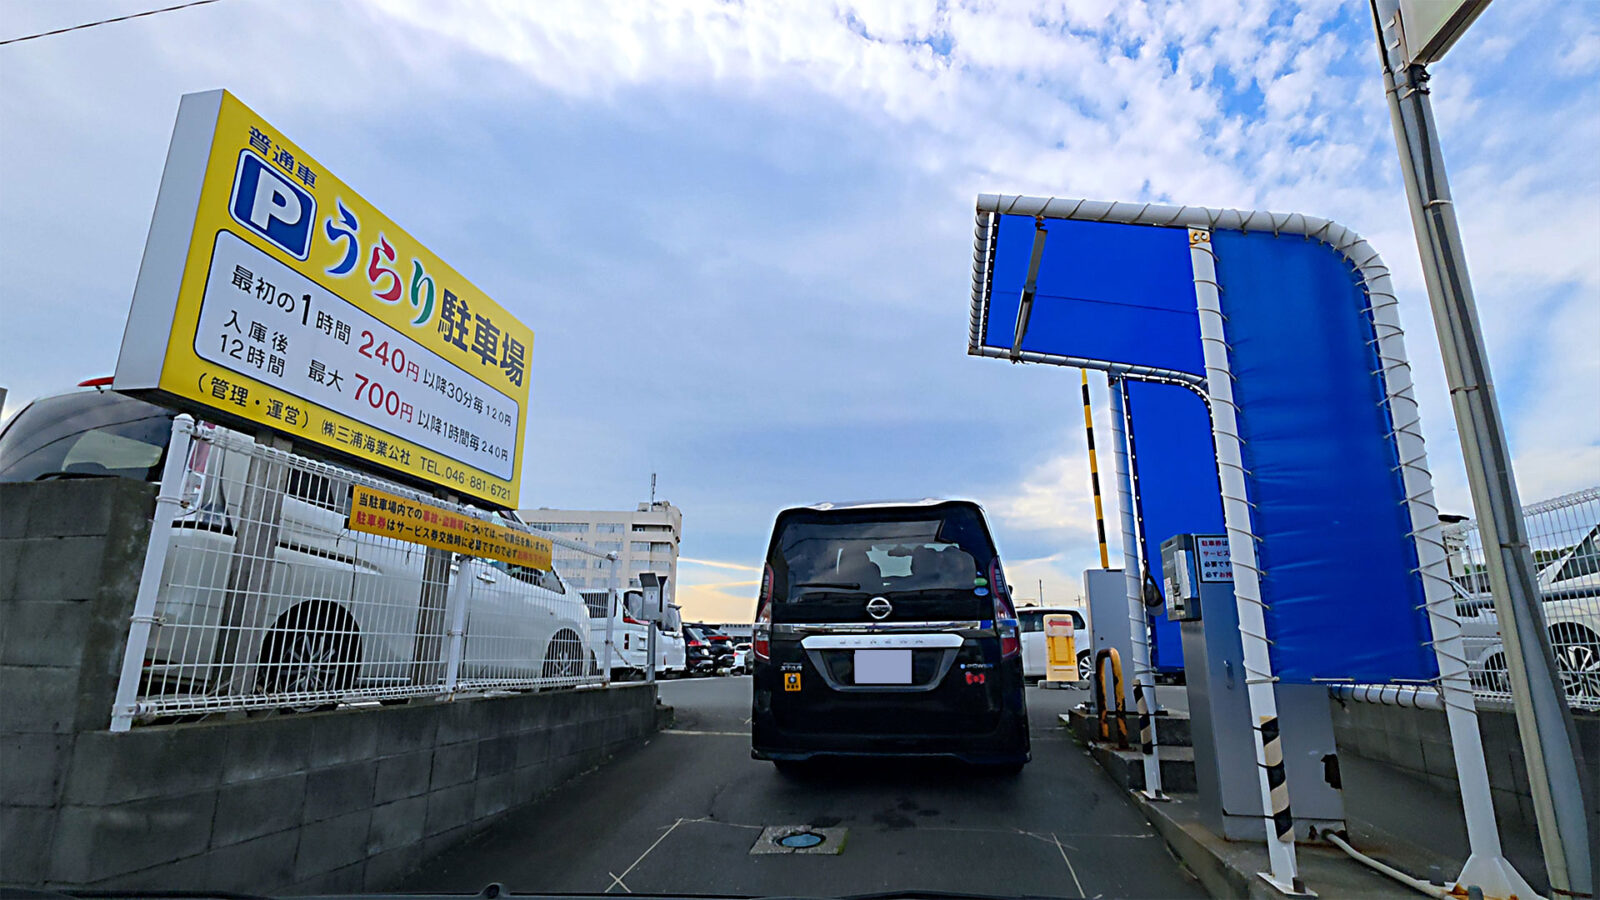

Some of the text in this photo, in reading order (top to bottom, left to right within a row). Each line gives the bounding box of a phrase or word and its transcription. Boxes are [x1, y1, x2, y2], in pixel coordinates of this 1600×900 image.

[249, 125, 318, 189] 普通車
[250, 168, 302, 230] P
[223, 309, 289, 355] 入庫後
[231, 265, 352, 345] 最初の1時間
[358, 330, 420, 382] 240円
[218, 333, 286, 378] 12時間
[308, 360, 344, 393] 最大
[353, 373, 414, 424] 700円
